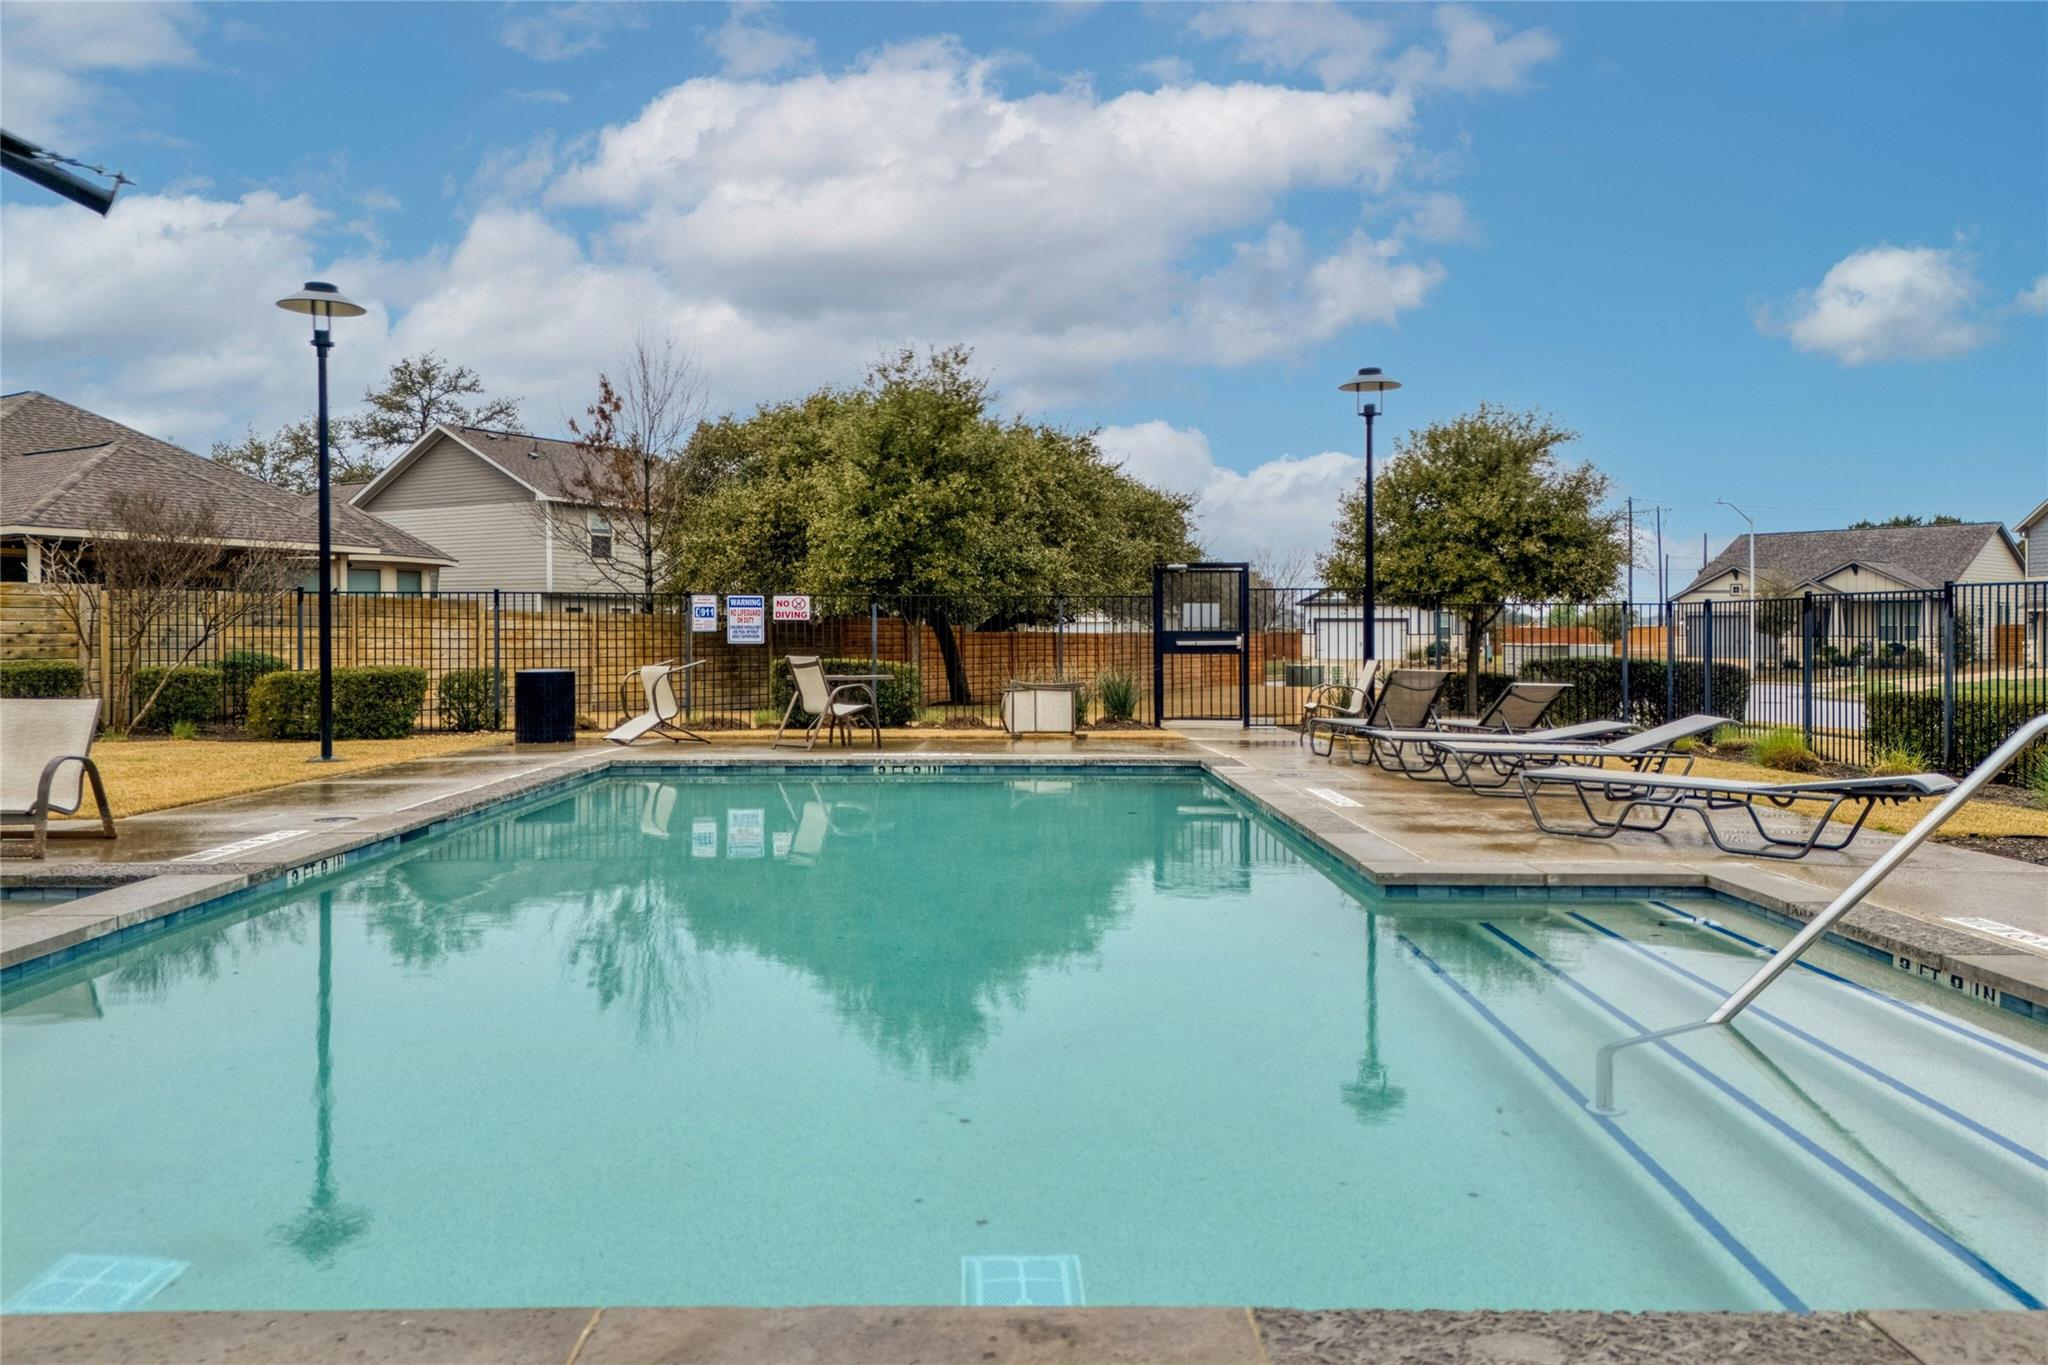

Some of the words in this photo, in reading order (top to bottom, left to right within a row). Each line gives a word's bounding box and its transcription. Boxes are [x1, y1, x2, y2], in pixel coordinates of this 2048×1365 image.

[700, 607, 714, 617] 911
[1919, 964, 1941, 981] FT
[1975, 982, 1996, 1002] IN
